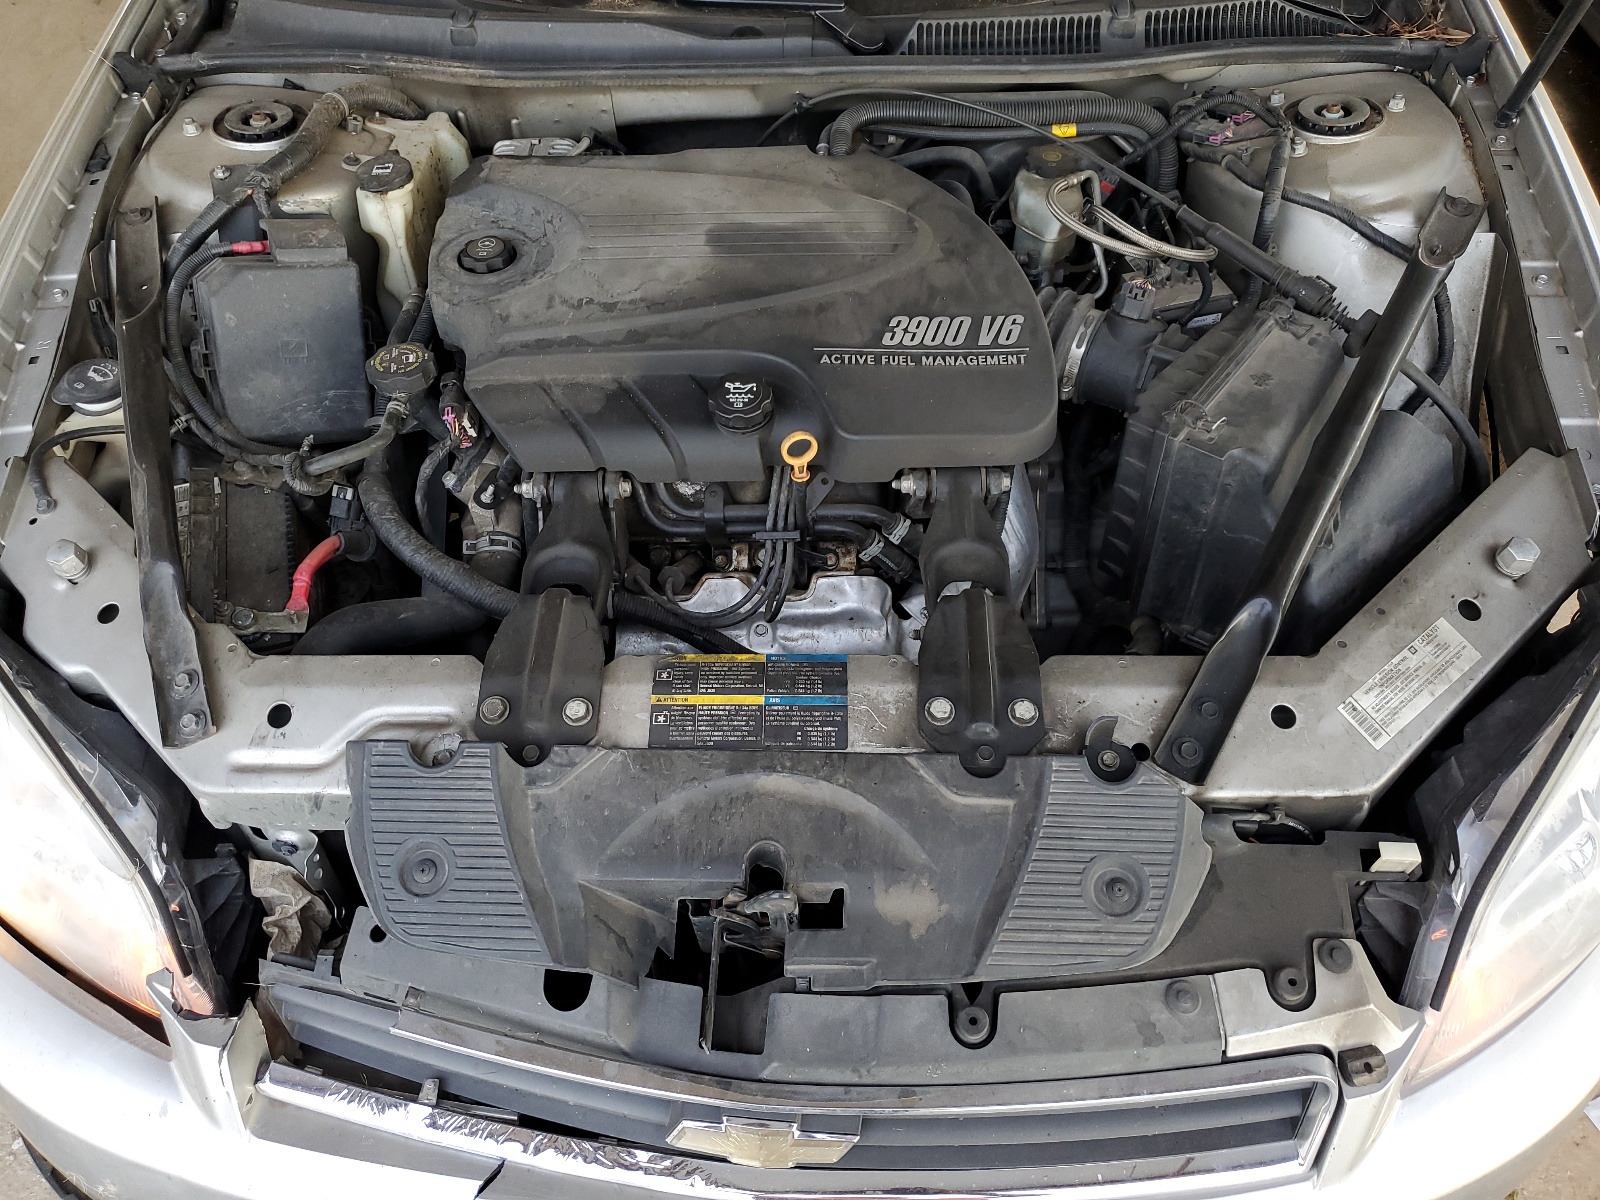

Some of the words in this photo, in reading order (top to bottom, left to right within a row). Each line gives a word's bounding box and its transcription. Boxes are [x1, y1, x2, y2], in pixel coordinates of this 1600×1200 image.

[881, 315, 972, 347] 3900
[977, 314, 1025, 346] V6
[820, 354, 876, 365] ACTIVE
[881, 355, 916, 366] FUEL
[921, 354, 1028, 366] MANAGEMENT
[1416, 624, 1440, 645] CATALYST
[1392, 654, 1408, 670] CONTROL
[1378, 667, 1402, 688] INFORMATION
